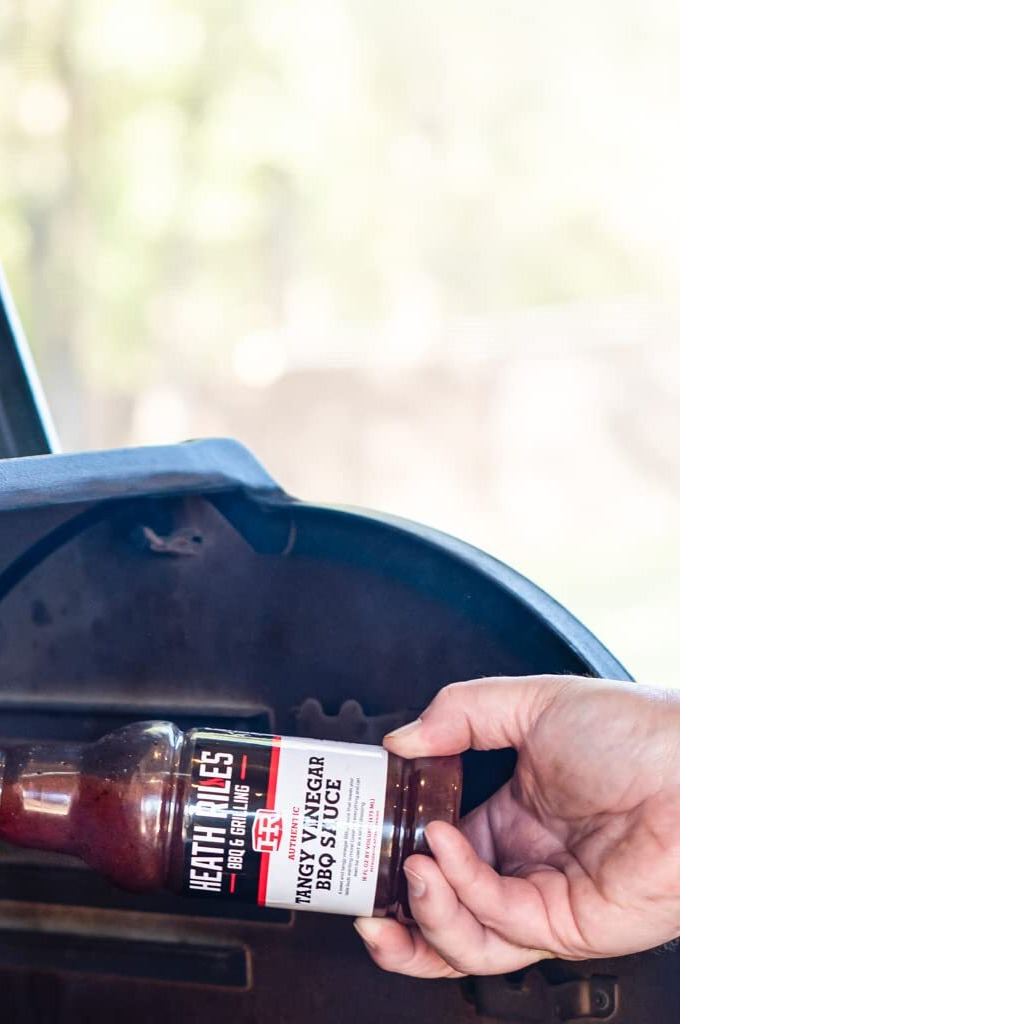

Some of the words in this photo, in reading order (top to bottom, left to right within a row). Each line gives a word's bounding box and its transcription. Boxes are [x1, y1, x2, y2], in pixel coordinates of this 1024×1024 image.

[195, 751, 234, 818] RILES
[230, 784, 250, 835] GRILLING
[189, 826, 226, 892] HEATH
[229, 838, 245, 846] &
[288, 806, 300, 860] AUTHENTIC
[227, 849, 246, 870] BBQ
[295, 849, 315, 904] TANGY
[316, 853, 337, 891] BBQ
